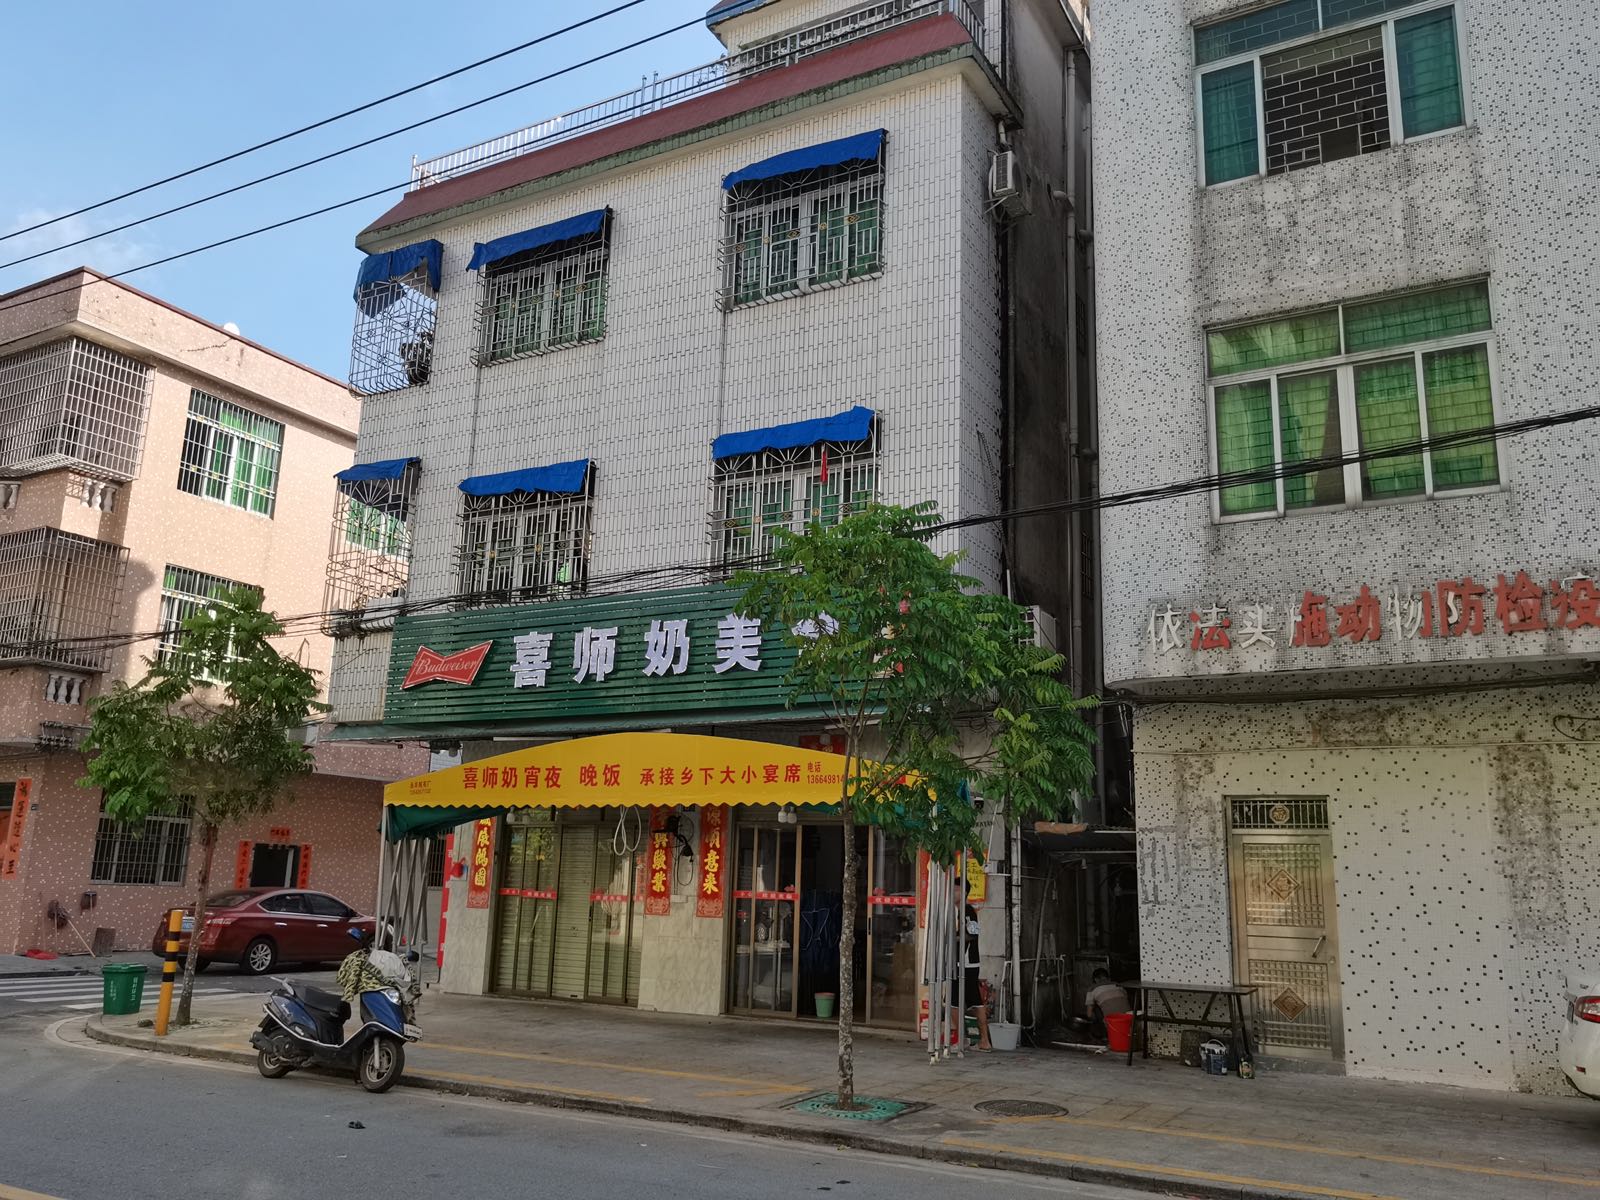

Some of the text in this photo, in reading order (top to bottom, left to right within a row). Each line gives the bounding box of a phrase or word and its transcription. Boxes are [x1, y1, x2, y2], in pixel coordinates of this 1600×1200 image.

[415, 657, 479, 676] Budweiser
[463, 763, 801, 789] 喜师奶宵夜 晚饭 承接乡下大小宴席
[807, 761, 822, 773] 电话
